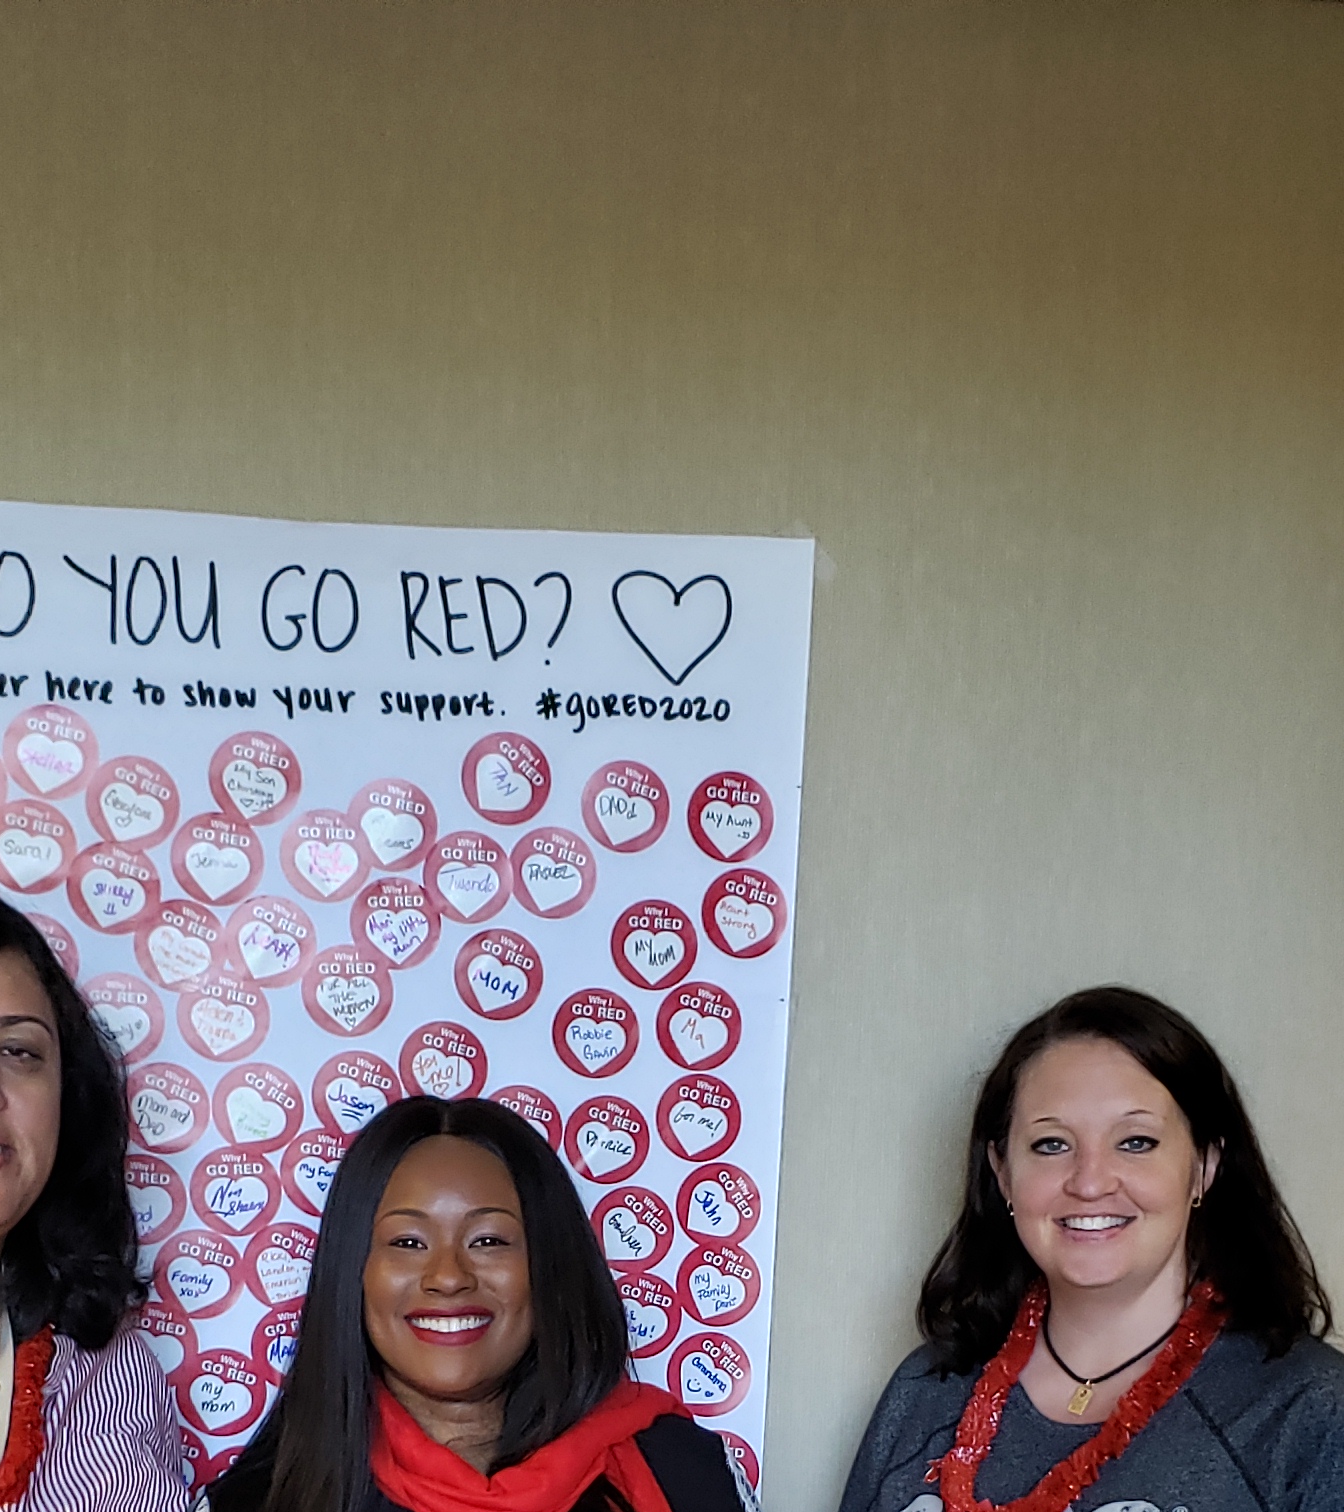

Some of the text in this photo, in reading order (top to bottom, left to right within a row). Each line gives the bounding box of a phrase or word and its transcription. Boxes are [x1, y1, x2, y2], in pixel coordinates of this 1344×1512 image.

[63, 553, 221, 650] YOU
[262, 564, 358, 653] GO
[401, 570, 572, 666] RED?
[45, 670, 113, 704] here
[133, 678, 165, 704] to
[183, 680, 256, 709] show
[274, 686, 355, 720] your
[380, 691, 505, 721] support.
[706, 787, 760, 804] GO RED
[629, 915, 683, 930] GO RED
[319, 963, 375, 974] GO RED
[472, 968, 519, 1000] MOM
[572, 1003, 626, 1021] GO RED
[328, 1084, 375, 1114] Jason
[679, 1085, 731, 1109] GO RED
[178, 1242, 235, 1267] GO RED
